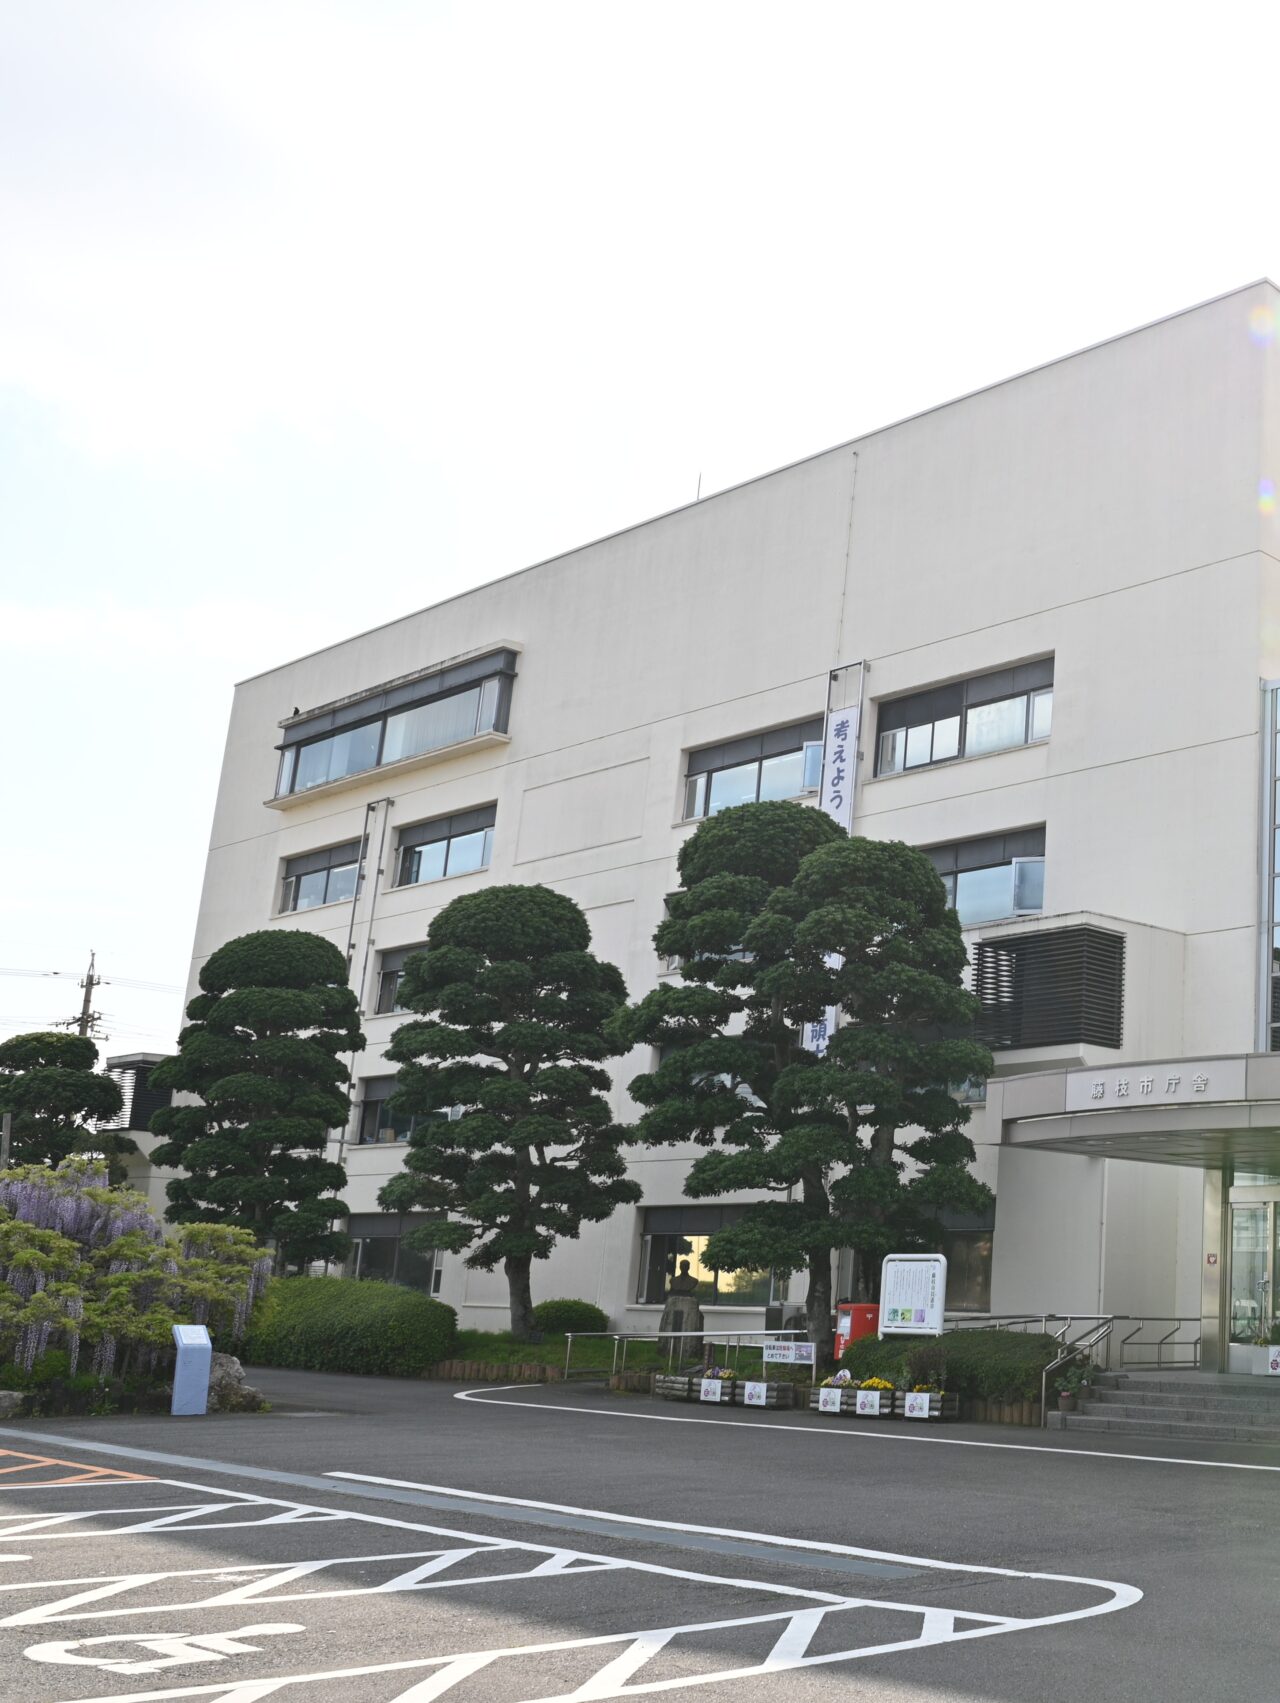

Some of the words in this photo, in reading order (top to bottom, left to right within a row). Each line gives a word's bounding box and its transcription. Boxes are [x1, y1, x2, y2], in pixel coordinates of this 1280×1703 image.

[830, 719, 850, 810] 考えよう
[1090, 1072, 1209, 1099] 藤枝市庁舎
